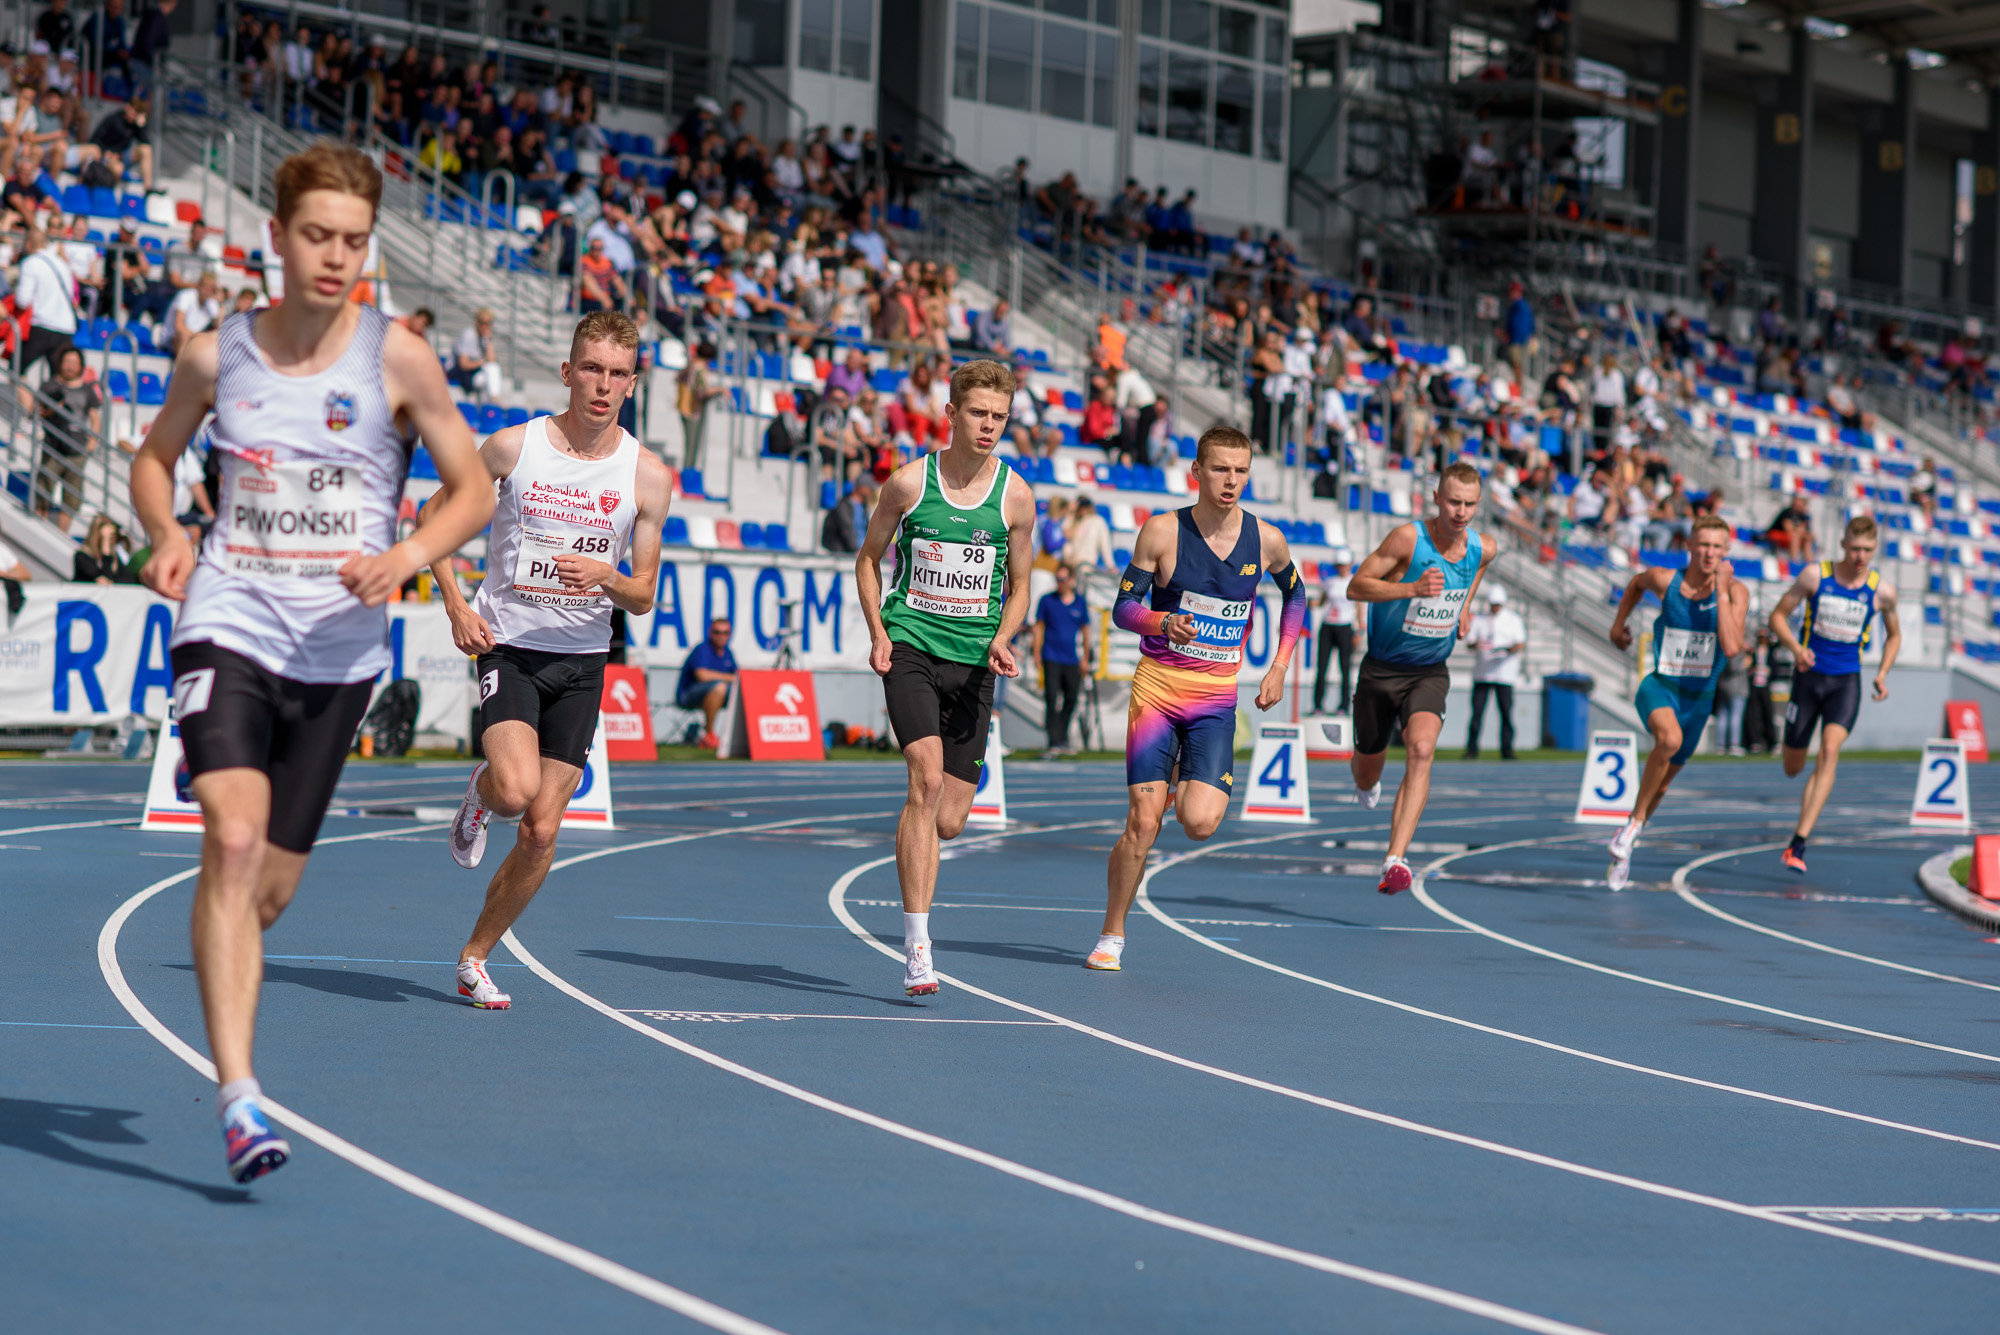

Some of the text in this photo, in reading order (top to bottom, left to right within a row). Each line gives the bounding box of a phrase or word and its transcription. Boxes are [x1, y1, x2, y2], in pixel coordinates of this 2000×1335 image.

[308, 468, 344, 492] 84
[234, 505, 356, 535] PIWOŃSKI
[922, 527, 940, 535] UMCS
[571, 536, 610, 554] 458
[919, 551, 942, 561] ORLEN
[962, 547, 985, 563] 98
[913, 565, 989, 590] KITLIŃSKI
[520, 593, 589, 607] RADOM 2022
[1444, 591, 1465, 602] 666
[912, 598, 972, 614] RADOM 2022
[1221, 603, 1248, 617] 619
[1417, 606, 1455, 620] GAJDA
[1191, 620, 1244, 641] WALSKI
[1174, 644, 1208, 658] RADOM
[1209, 652, 1228, 660] 2022
[1675, 648, 1700, 660] RAK
[181, 675, 201, 711] 7
[1258, 743, 1296, 799] 4
[1594, 751, 1626, 801] 3
[1927, 758, 1957, 804] 2
